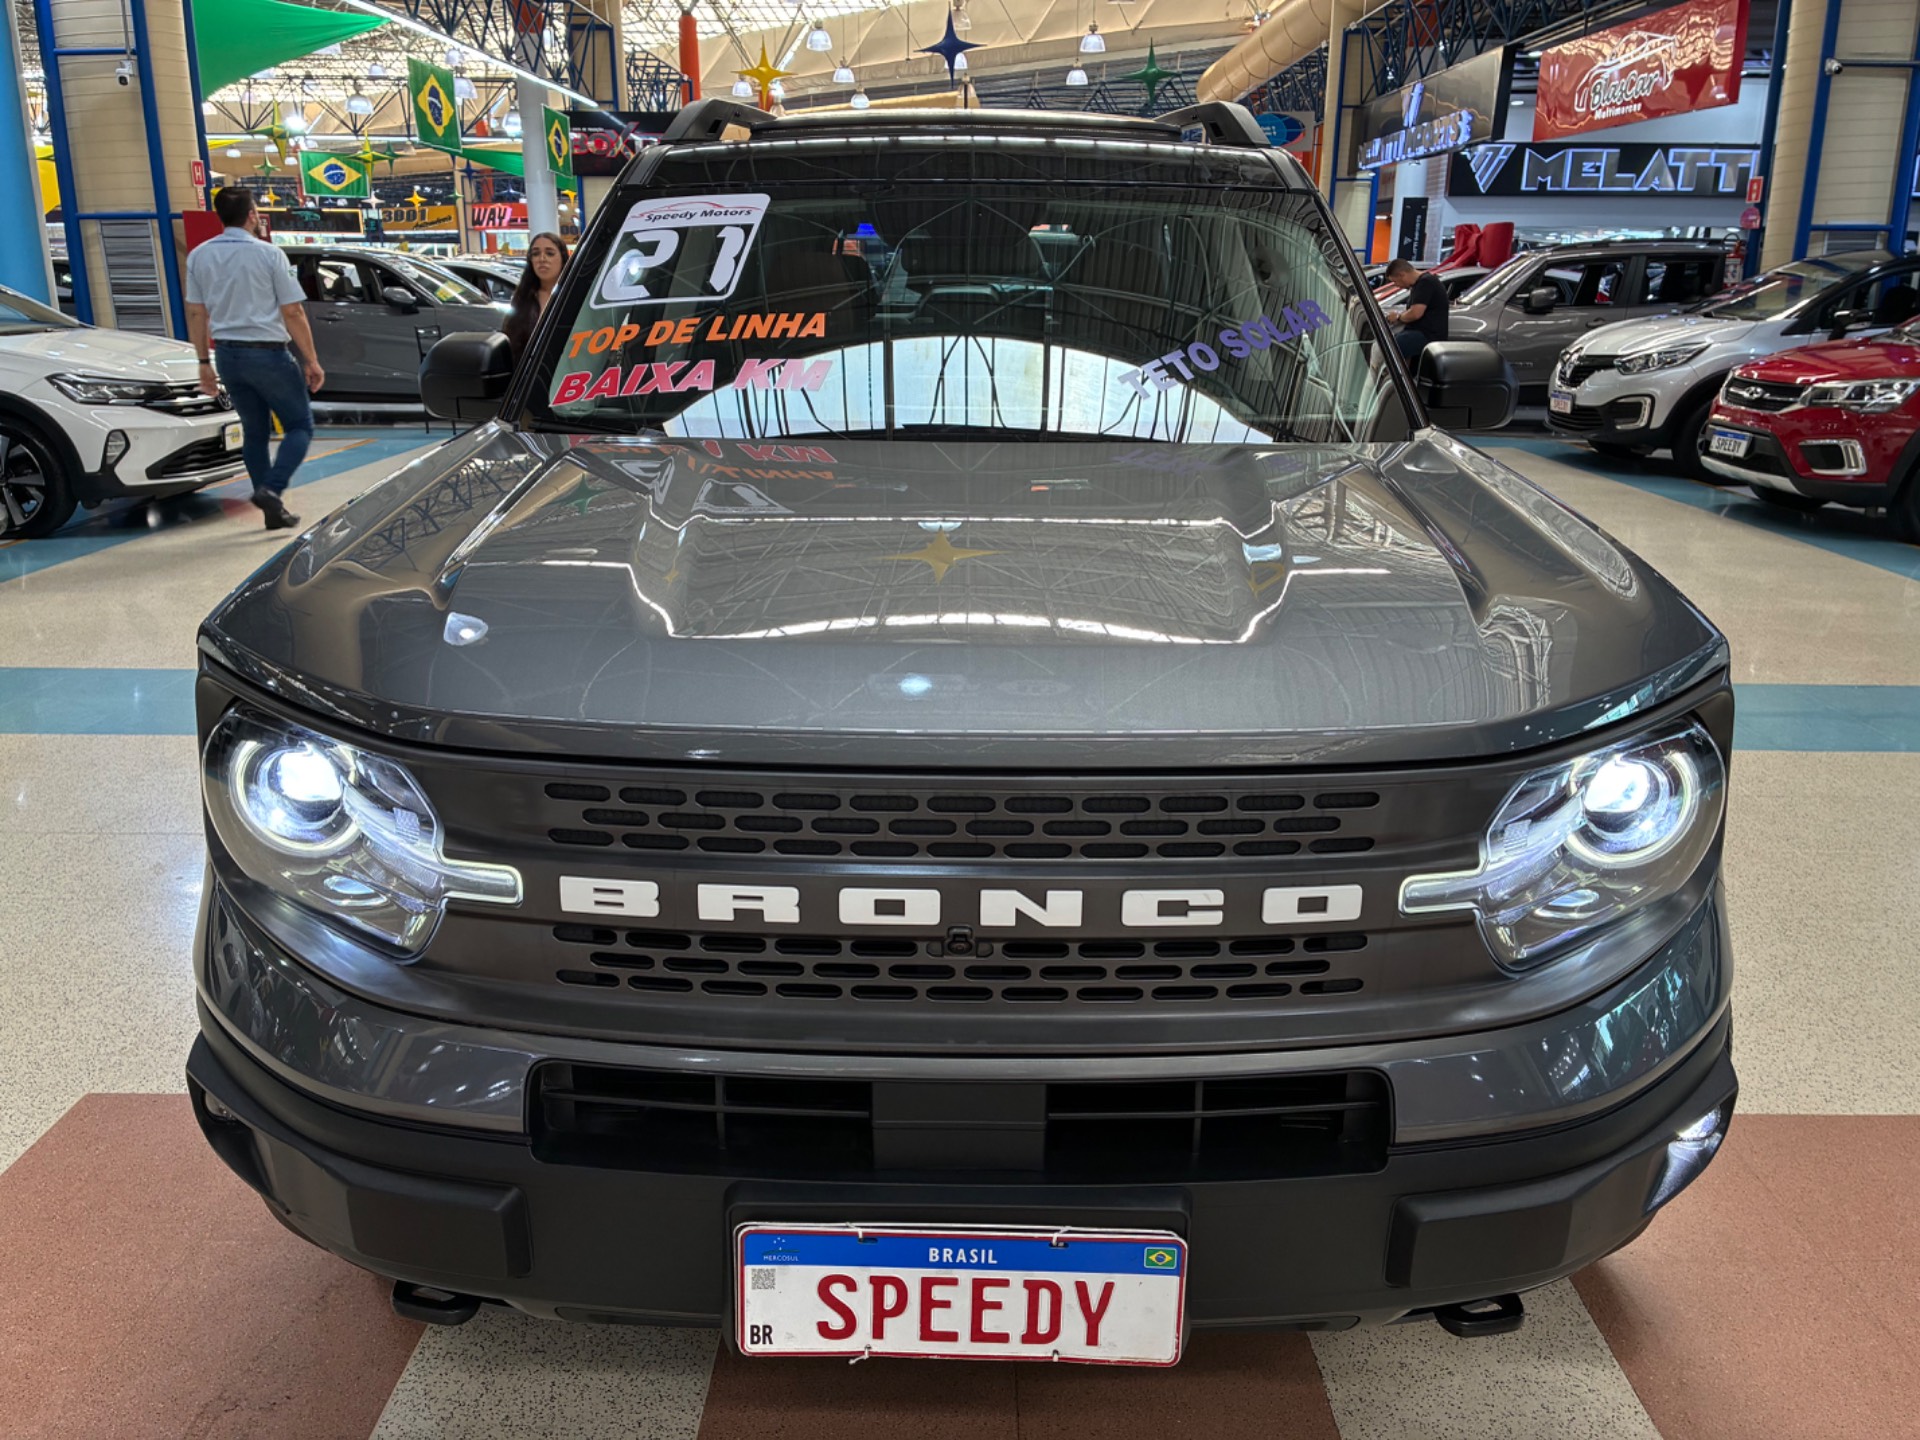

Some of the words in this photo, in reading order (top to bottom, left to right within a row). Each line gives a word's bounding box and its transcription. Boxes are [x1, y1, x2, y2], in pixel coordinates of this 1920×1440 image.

[1590, 70, 1660, 110] BlasCar
[382, 208, 427, 223] 3001
[471, 206, 511, 227] WAY
[644, 210, 697, 223] Speedy
[700, 207, 752, 218] Motors
[601, 226, 745, 300] 21
[568, 324, 640, 358] TOP
[644, 318, 700, 346] DE
[706, 312, 826, 341] LINHA
[1117, 342, 1220, 400] TETO
[1219, 299, 1333, 358] SOLAR
[549, 359, 715, 407] BAIXA
[733, 358, 833, 392] KM
[1715, 437, 1742, 453] SPEEDY
[559, 875, 1363, 927] BRONCO
[763, 1254, 799, 1262] MERCOSUL
[928, 1247, 998, 1265] BRASIL
[816, 1273, 1115, 1347] SPEEDY
[749, 1325, 773, 1345] BR
